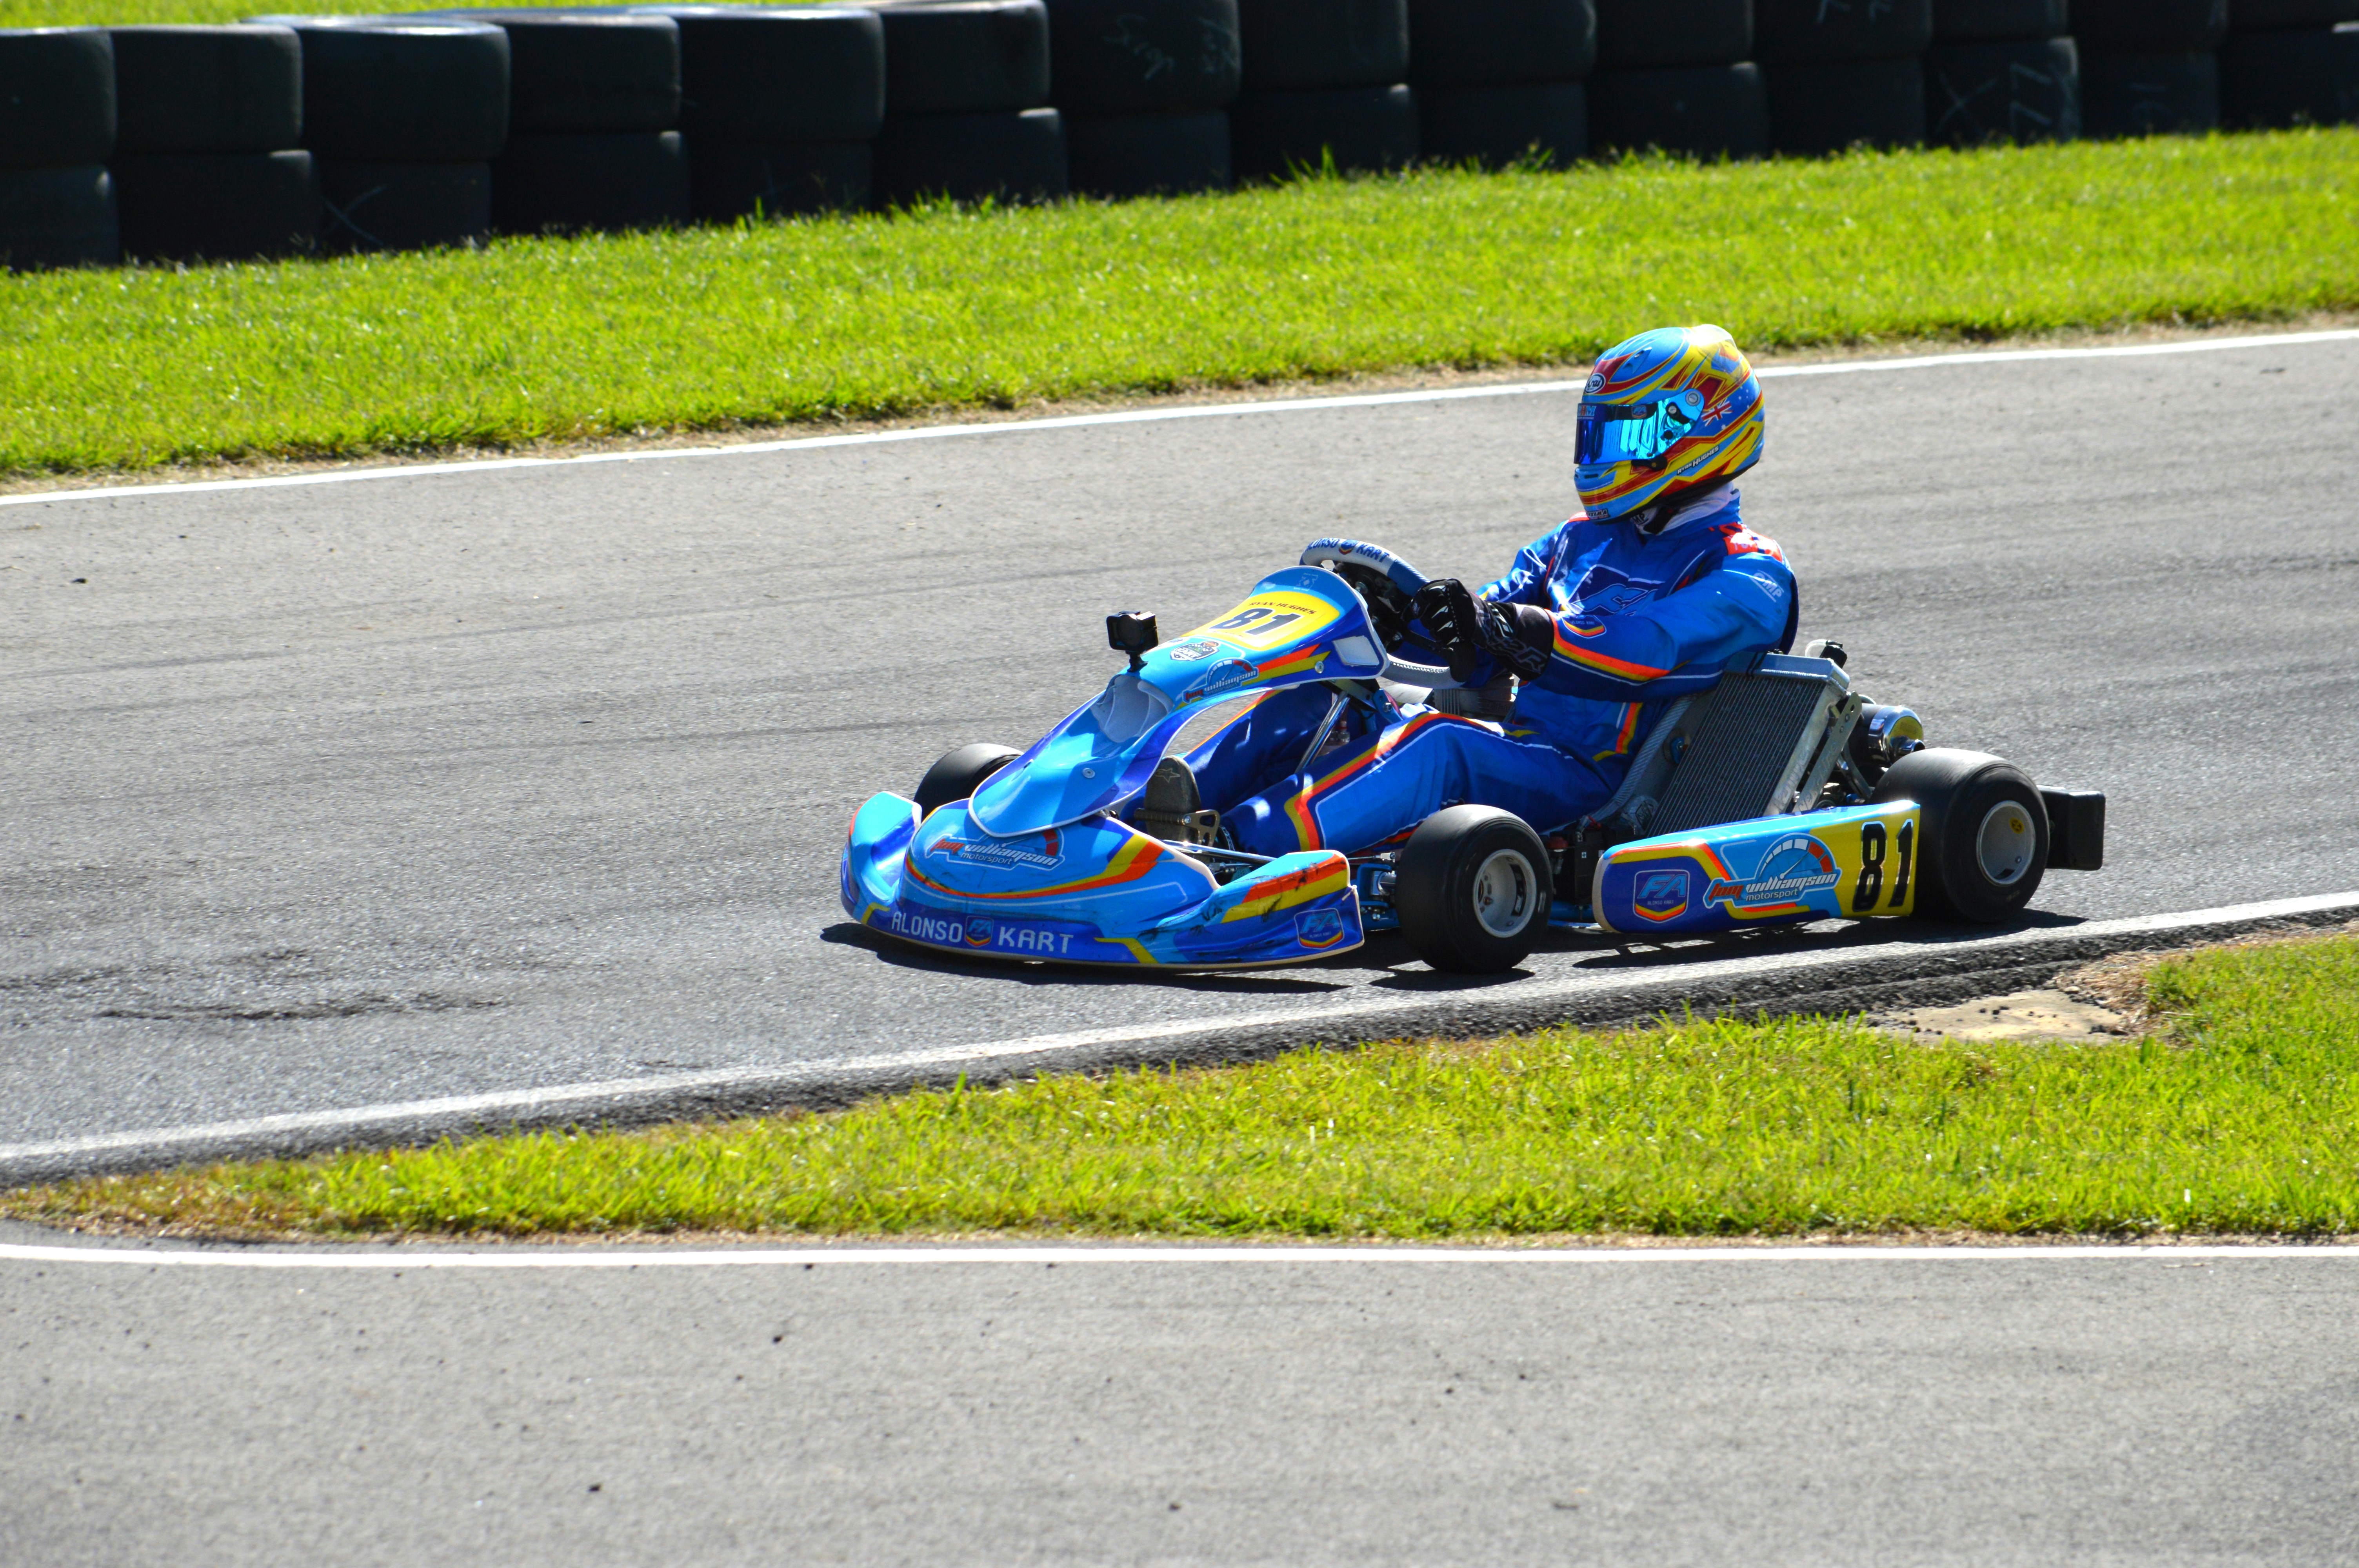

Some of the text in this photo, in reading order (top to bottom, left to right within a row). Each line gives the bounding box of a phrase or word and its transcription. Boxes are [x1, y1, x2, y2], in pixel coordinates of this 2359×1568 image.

[1677, 445, 1719, 474] RYAN HUGHES
[1356, 543, 1390, 563] KART
[1276, 603, 1317, 614] HUGHES
[1209, 607, 1303, 636] 81
[1204, 670, 1256, 691] williamson
[1207, 682, 1239, 695] motorsport
[961, 852, 1013, 865] motorsport
[965, 843, 1059, 866] williamson
[1853, 818, 1914, 912] 81
[1637, 874, 1687, 898] FA
[1745, 873, 1837, 893] williamson
[1745, 888, 1798, 901] motorsport
[891, 911, 963, 943] ALONSO
[998, 926, 1074, 954] KART
